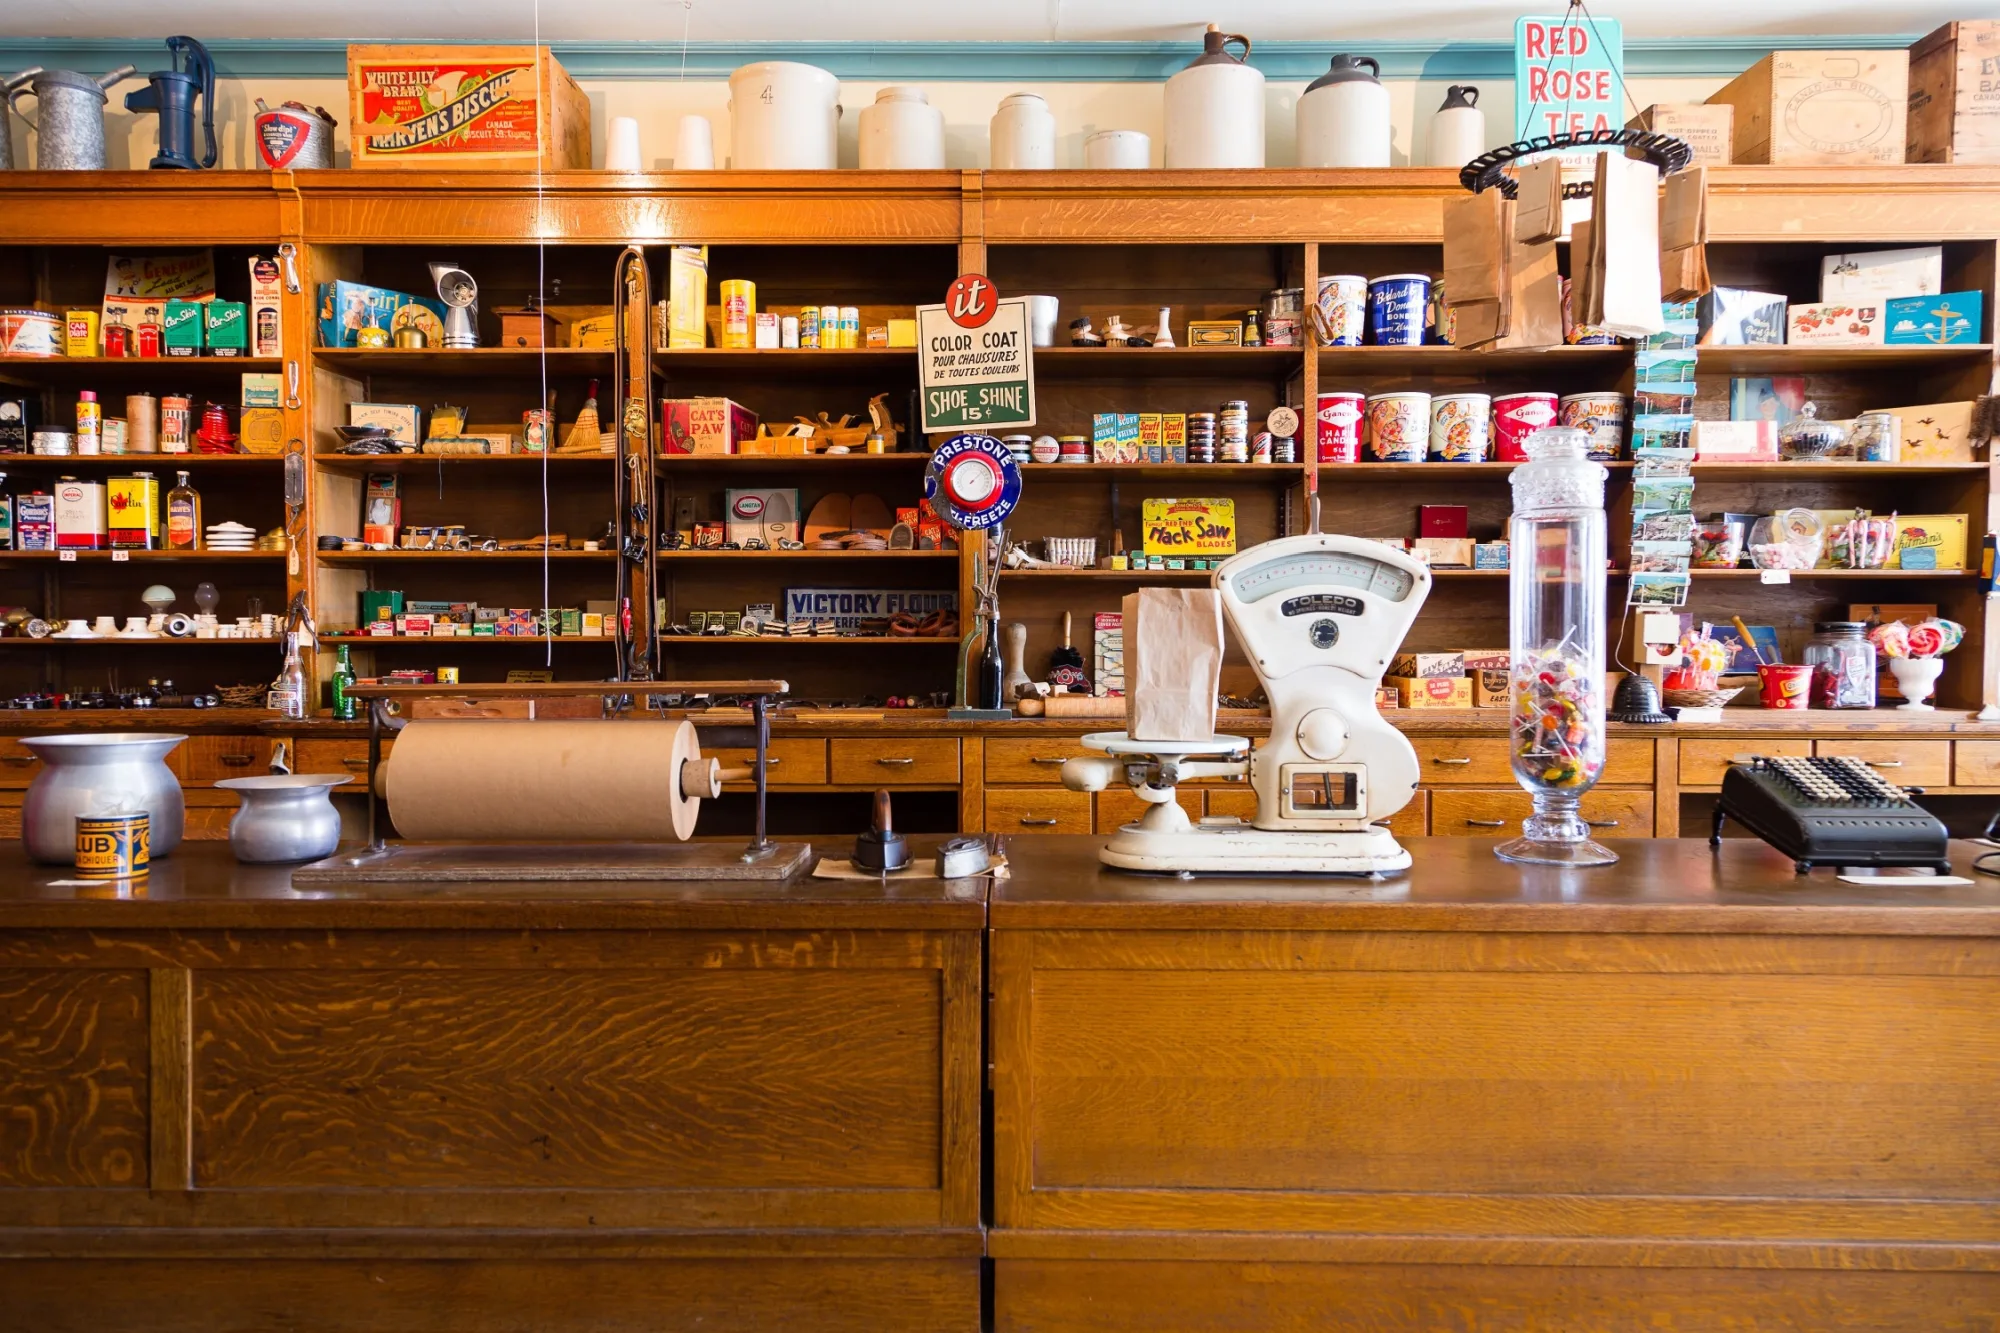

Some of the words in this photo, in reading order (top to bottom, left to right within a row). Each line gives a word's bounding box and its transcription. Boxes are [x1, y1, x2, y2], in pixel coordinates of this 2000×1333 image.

[1526, 22, 1588, 59] RED
[365, 71, 407, 84] WHITE
[408, 71, 436, 84] LILY
[1528, 65, 1611, 104] ROSE
[383, 85, 425, 98] BRAND
[760, 84, 773, 104] 4
[1545, 112, 1609, 143] TEA
[365, 289, 400, 312] Girl
[953, 279, 987, 319] it
[165, 308, 197, 328] Car-Skin
[209, 308, 242, 329] Car-Skin
[931, 335, 972, 353] COLOR
[982, 331, 1018, 349] COAT
[932, 353, 956, 367] POUR
[957, 350, 1019, 365] CHAUSSURES
[934, 369, 945, 379] DE
[948, 366, 980, 378] TOUTES
[981, 364, 1020, 375] COULEURS
[929, 389, 969, 418] SHOE
[979, 386, 1025, 414] SHINE
[691, 410, 725, 421] CAT'S
[691, 423, 725, 434] PAW
[1140, 421, 1160, 432] Scuff
[1142, 431, 1158, 440] kote
[1164, 421, 1184, 432] Scuff
[1166, 431, 1182, 440] kote
[934, 436, 1012, 467] PRESTONE
[1149, 516, 1195, 545] Hack
[1195, 516, 1231, 539] Saw
[792, 594, 882, 613] VICTORY
[1288, 595, 1356, 607] TOLEDO
[1422, 660, 1442, 674] FIVE
